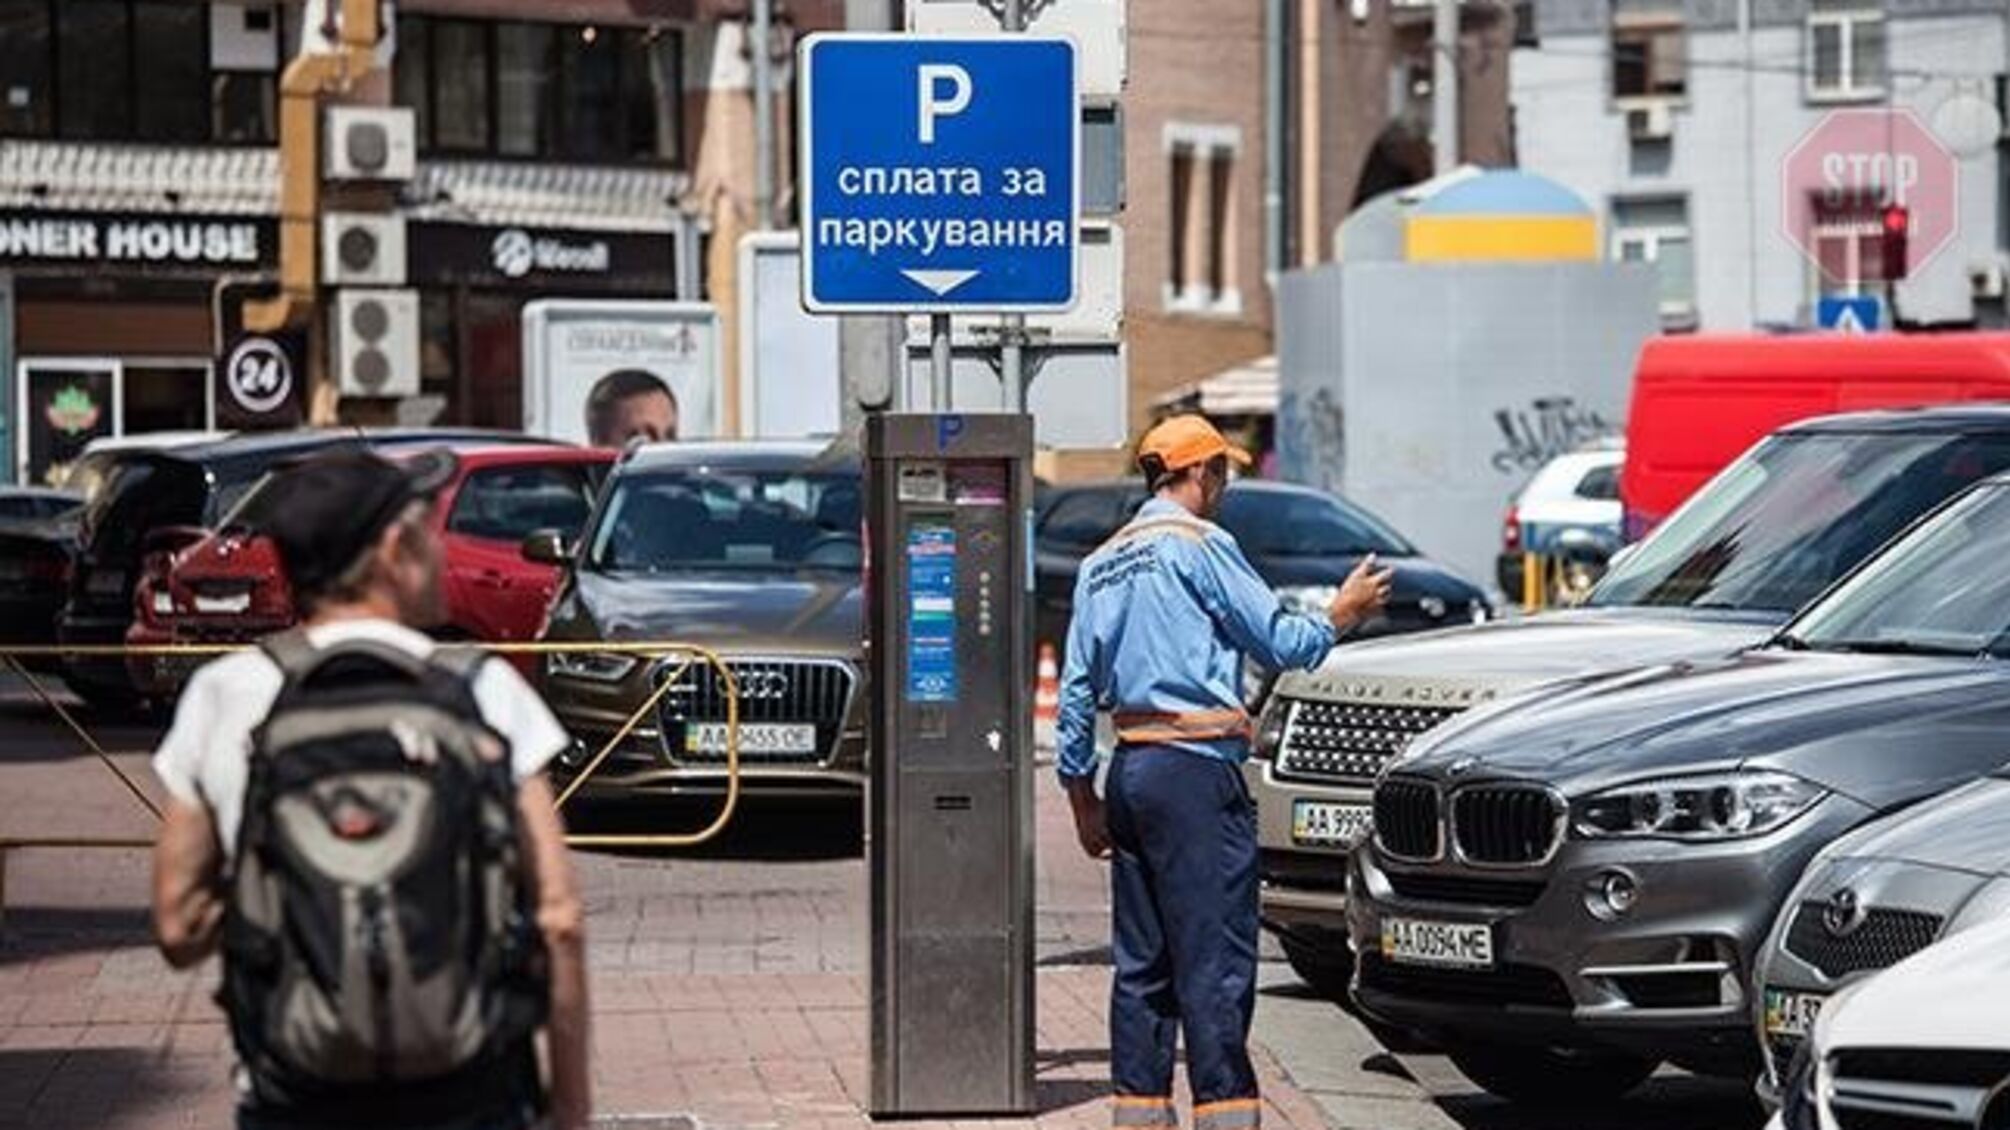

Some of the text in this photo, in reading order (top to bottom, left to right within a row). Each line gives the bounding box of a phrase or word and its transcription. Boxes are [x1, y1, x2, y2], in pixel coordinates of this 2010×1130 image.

[918, 63, 972, 143] P
[838, 167, 1046, 196] сплата за
[106, 222, 258, 262] HOUSE
[819, 218, 1065, 256] паркування
[241, 356, 278, 392] 24
[938, 414, 963, 454] P
